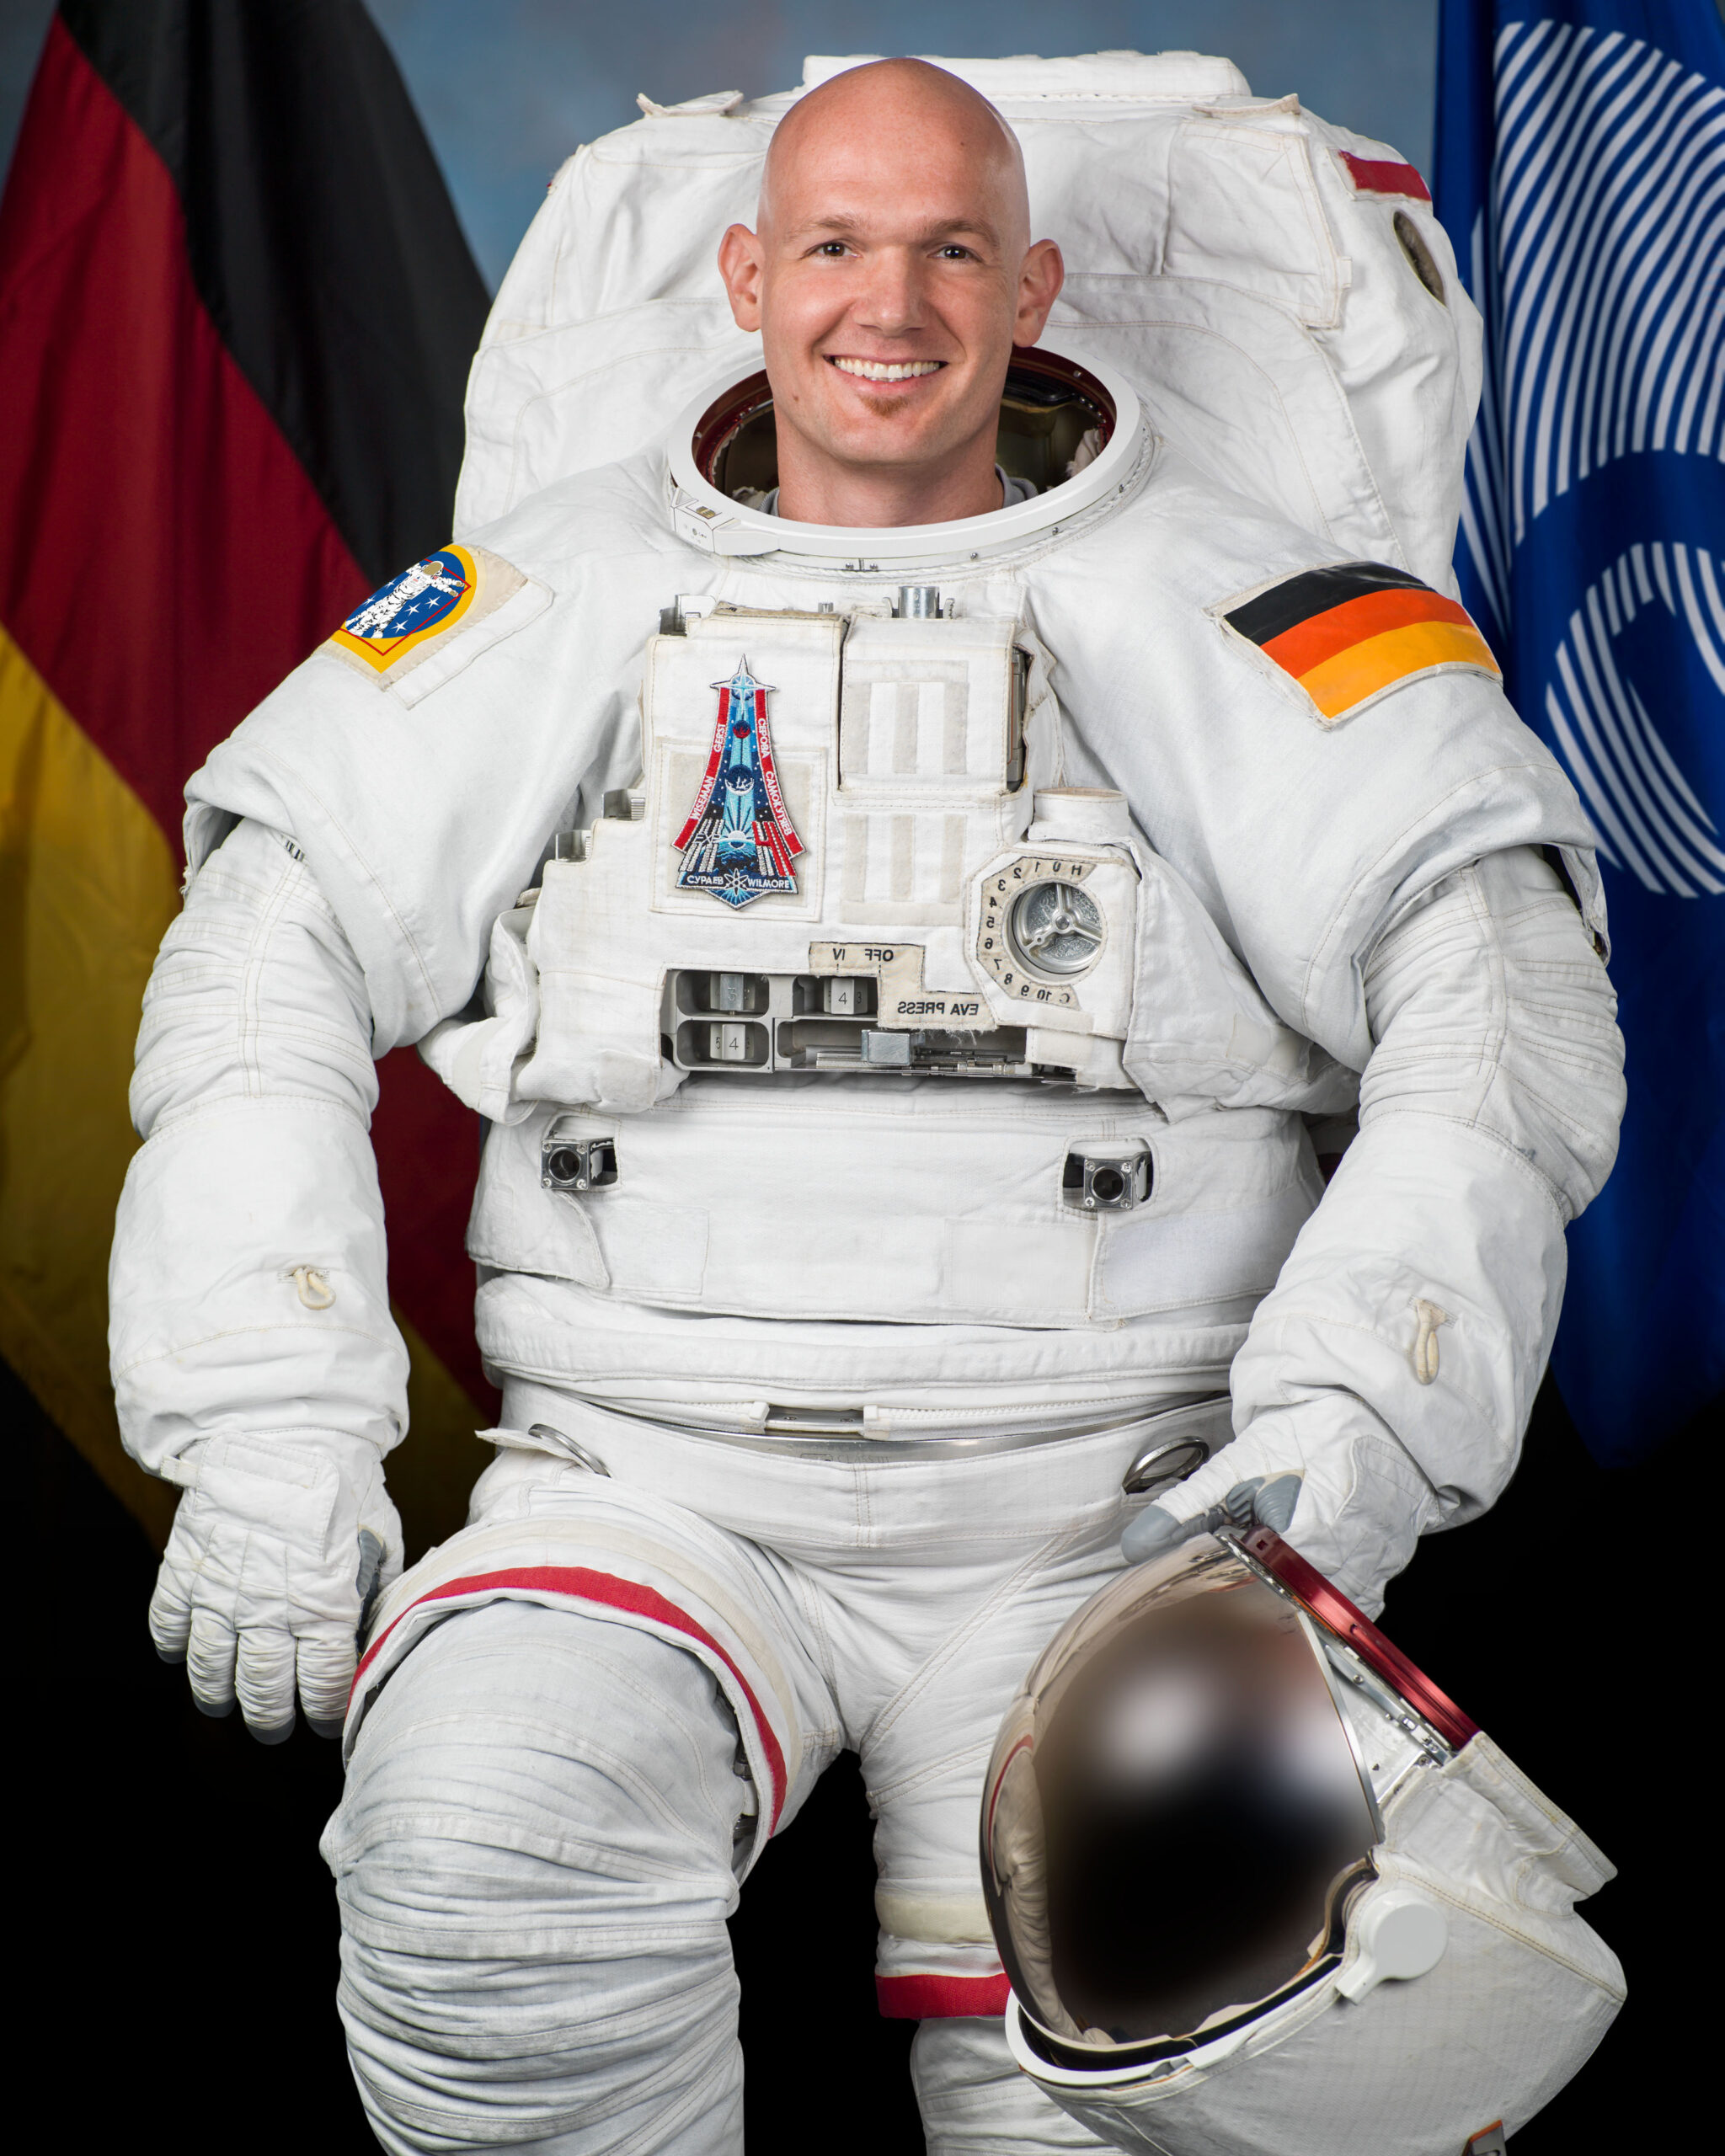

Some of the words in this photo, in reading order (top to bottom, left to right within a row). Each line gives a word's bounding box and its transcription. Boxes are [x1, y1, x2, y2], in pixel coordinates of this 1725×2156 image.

[713, 723, 726, 753] GERST
[690, 776, 714, 820] WISEMAN
[692, 833, 721, 844] EXP
[686, 874, 724, 885] СУРАЕВ
[747, 878, 791, 889] WILMORE
[838, 992, 847, 1005] 4
[729, 1038, 739, 1050] 4
